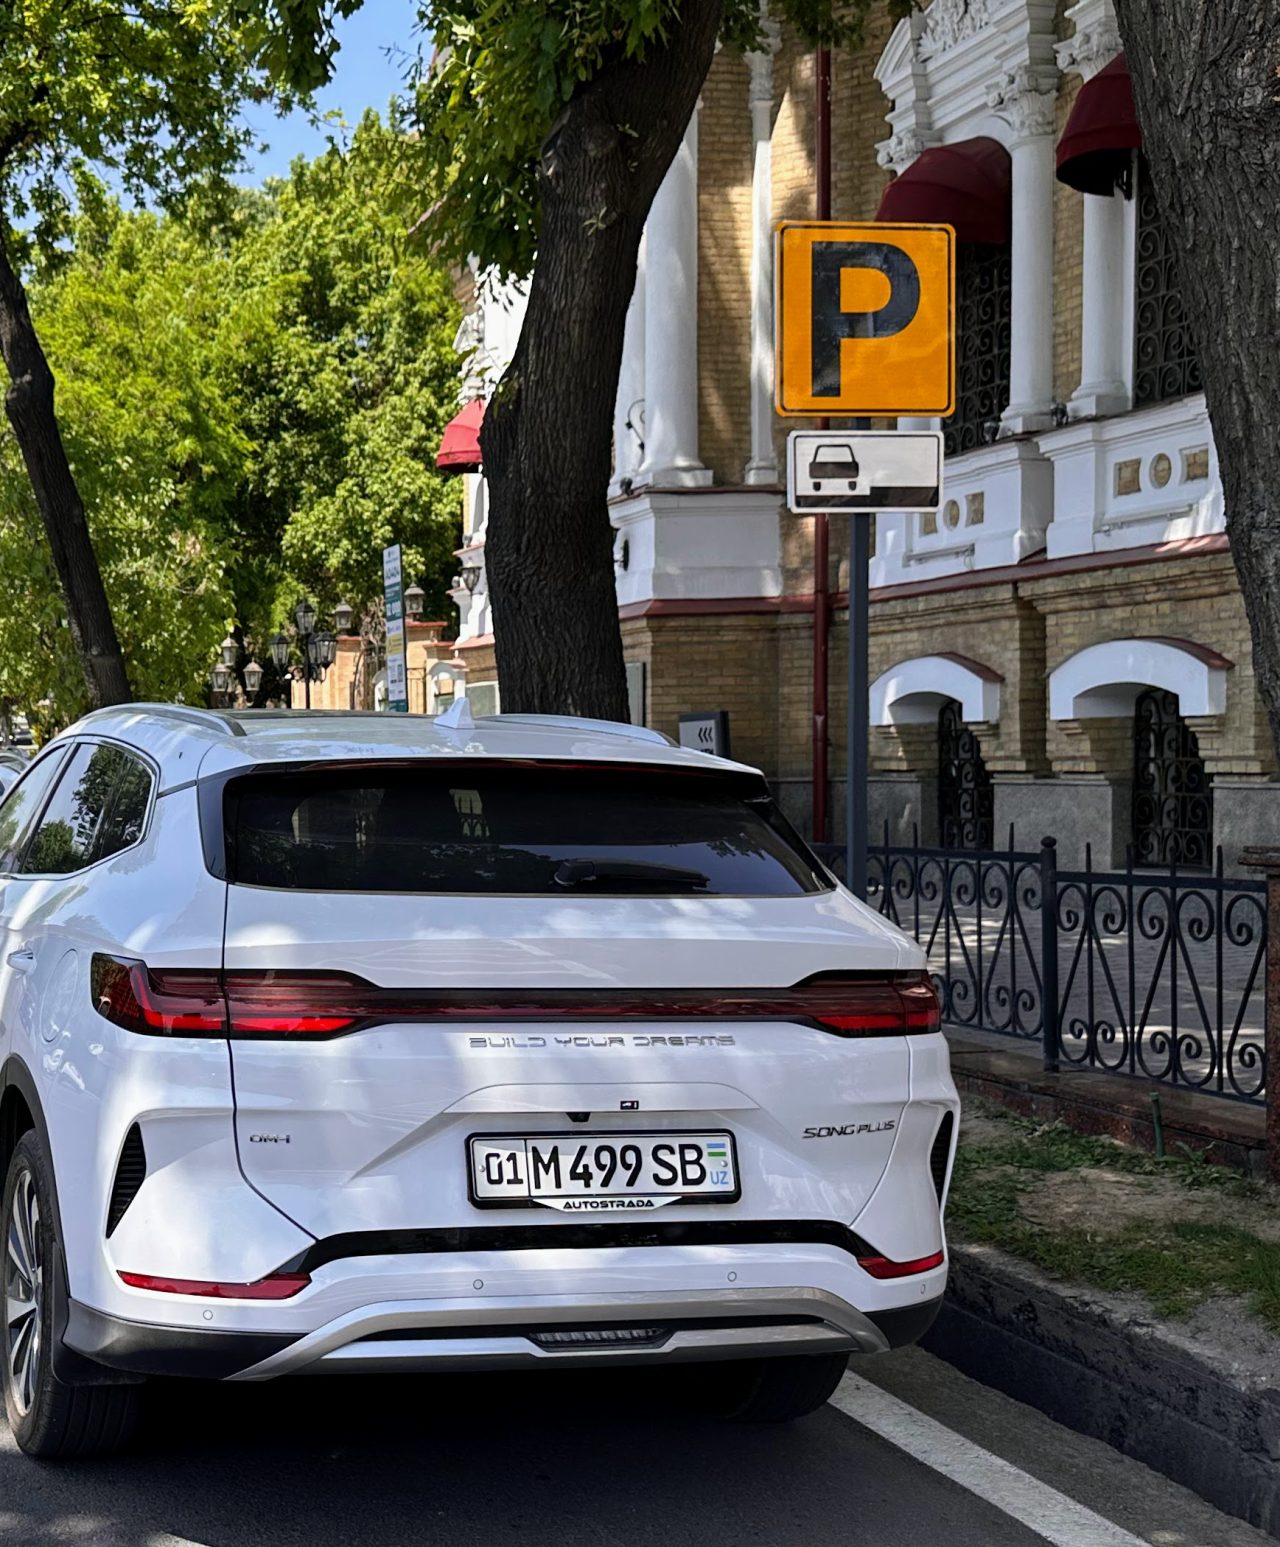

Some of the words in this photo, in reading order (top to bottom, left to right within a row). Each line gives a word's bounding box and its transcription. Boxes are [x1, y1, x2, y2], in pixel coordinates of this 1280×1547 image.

[811, 240, 921, 397] P
[469, 1037, 547, 1049] BUILD
[553, 1036, 625, 1048] YOUR
[632, 1035, 737, 1047] DREAMS
[802, 1124, 856, 1139] SONG
[857, 1119, 895, 1134] PLUS
[485, 1152, 524, 1185] 01
[531, 1145, 562, 1189] M
[569, 1144, 643, 1188] 499
[651, 1143, 707, 1187] SB
[710, 1170, 729, 1185] UZ
[563, 1199, 655, 1210] AUTOSTRADA
